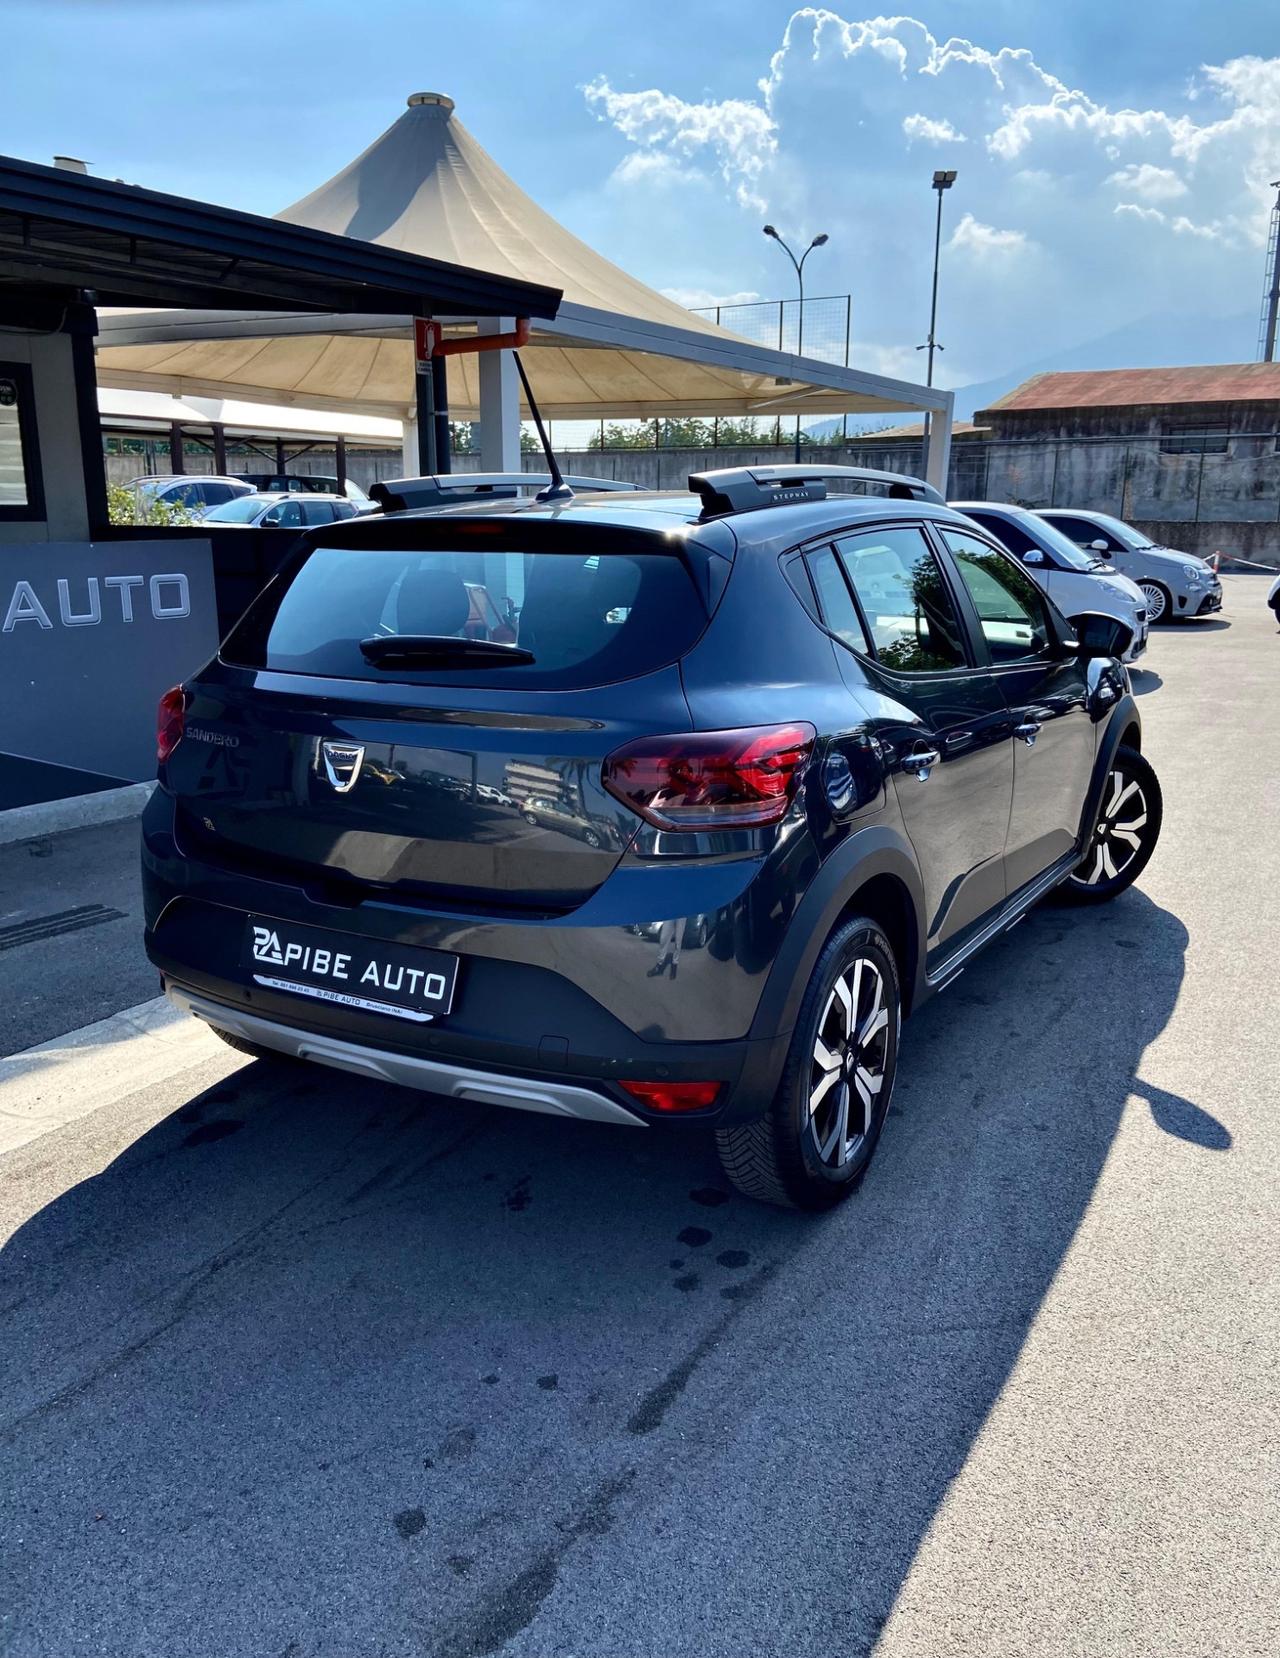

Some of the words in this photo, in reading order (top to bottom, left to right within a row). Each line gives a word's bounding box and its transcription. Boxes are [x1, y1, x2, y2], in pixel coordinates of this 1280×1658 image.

[773, 491, 809, 501] STEPWAY
[2, 573, 191, 632] AUTO
[186, 727, 240, 748] SANDERO
[326, 750, 356, 761] DACIA
[284, 942, 352, 980] PIBE
[360, 960, 446, 1000] AUTO
[323, 991, 339, 1001] PIBE
[341, 996, 361, 1006] AUTO
